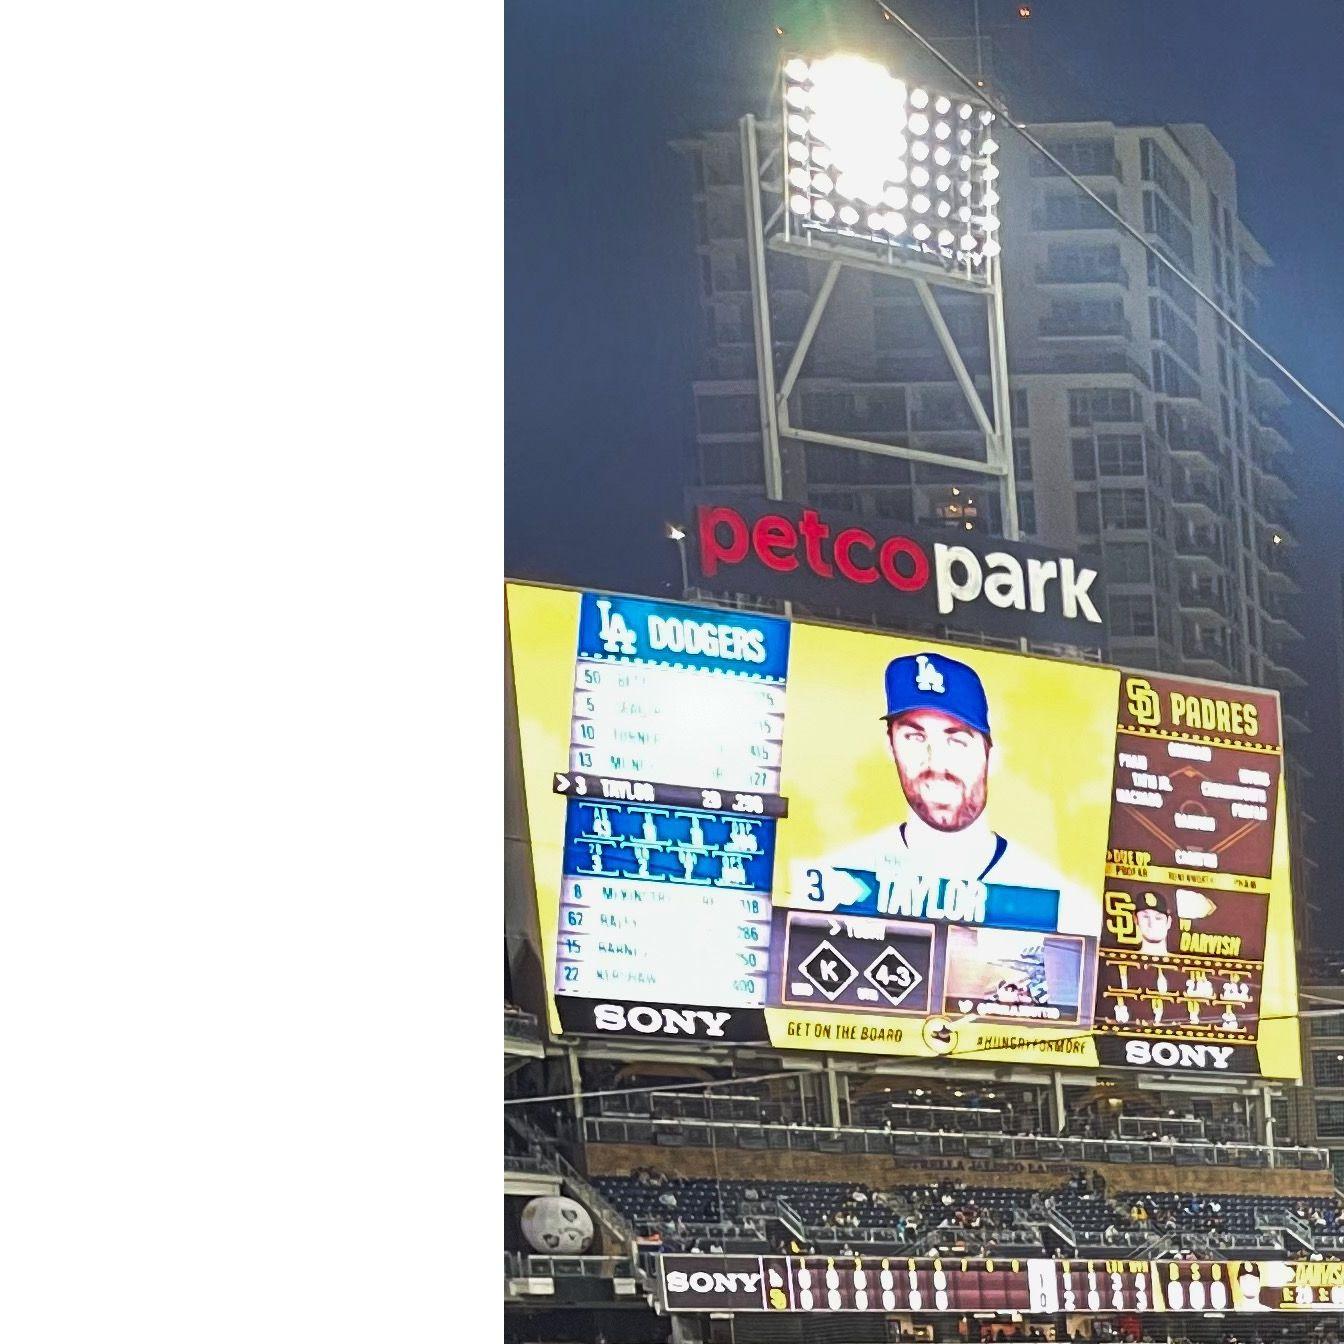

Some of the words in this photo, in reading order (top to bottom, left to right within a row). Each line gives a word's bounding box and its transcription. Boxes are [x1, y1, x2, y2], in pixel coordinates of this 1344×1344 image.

[648, 615, 766, 663] DODGERS
[584, 669, 601, 685] 50
[1170, 692, 1259, 737] PADRES
[580, 723, 595, 740] 10
[578, 752, 593, 768] 13
[806, 869, 824, 902] 3
[876, 873, 987, 922] TAYLOR
[820, 960, 839, 982] K
[593, 1003, 732, 1037] SONY
[787, 1022, 811, 1038] GET
[814, 1023, 832, 1039] ON
[836, 1024, 857, 1041] THE
[861, 1026, 903, 1043] BOARD
[1126, 1040, 1234, 1068] SONY
[666, 1271, 762, 1293] SONY
